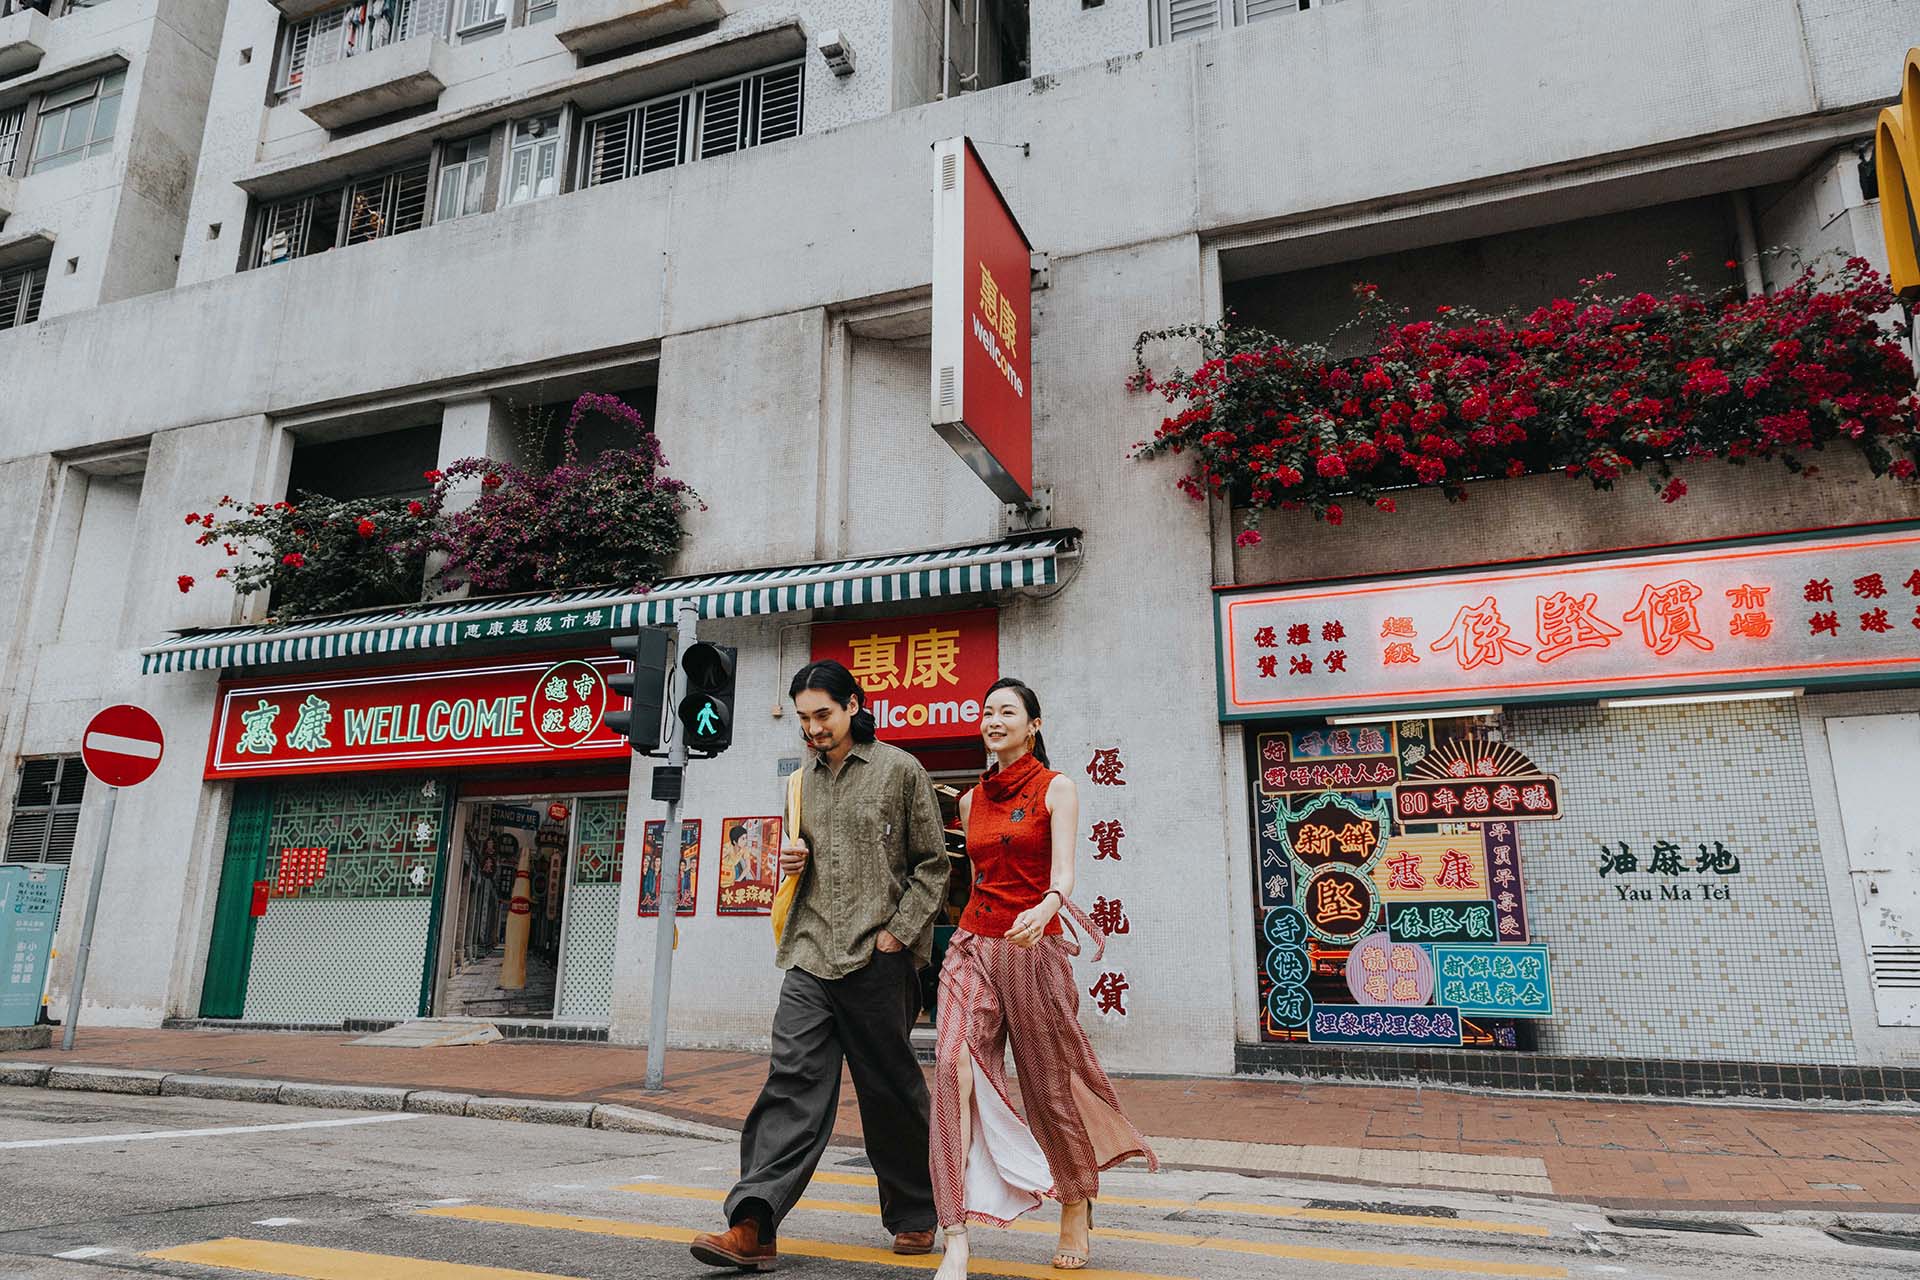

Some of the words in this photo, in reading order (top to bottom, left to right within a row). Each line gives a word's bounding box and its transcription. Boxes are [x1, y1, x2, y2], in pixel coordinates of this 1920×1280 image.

[979, 260, 1017, 359] 惠康
[972, 312, 1023, 398] wellcome
[463, 610, 604, 639] 惠康超級市場
[1430, 579, 1714, 670] 係堅價
[1725, 583, 1774, 640] 市場
[1803, 577, 1841, 637] 新鮮
[848, 628, 961, 693] 惠康
[1253, 625, 1279, 678] 優質
[1286, 623, 1312, 676] 糧油
[1321, 620, 1348, 673] 雜貨
[1379, 616, 1421, 665] 超級
[236, 694, 332, 754] 惠康
[343, 695, 527, 747] WELLCOME
[862, 699, 980, 729] llcome
[1299, 727, 1385, 754] 手慢無
[1294, 821, 1376, 858] 新鮮
[1598, 840, 1741, 878] 油麻地
[1086, 747, 1130, 1017] 優質靚貨
[1385, 850, 1479, 891] 惠康
[1487, 822, 1521, 936] 早買早享受
[1614, 884, 1652, 901] Yau
[1660, 884, 1692, 901] Ma
[1697, 883, 1731, 901] Tei
[1391, 906, 1494, 938] 係堅價
[1271, 914, 1304, 1020] 手快有
[1443, 954, 1541, 979] 新鮮乾貨
[1444, 980, 1545, 1005] 樣樣齊全
